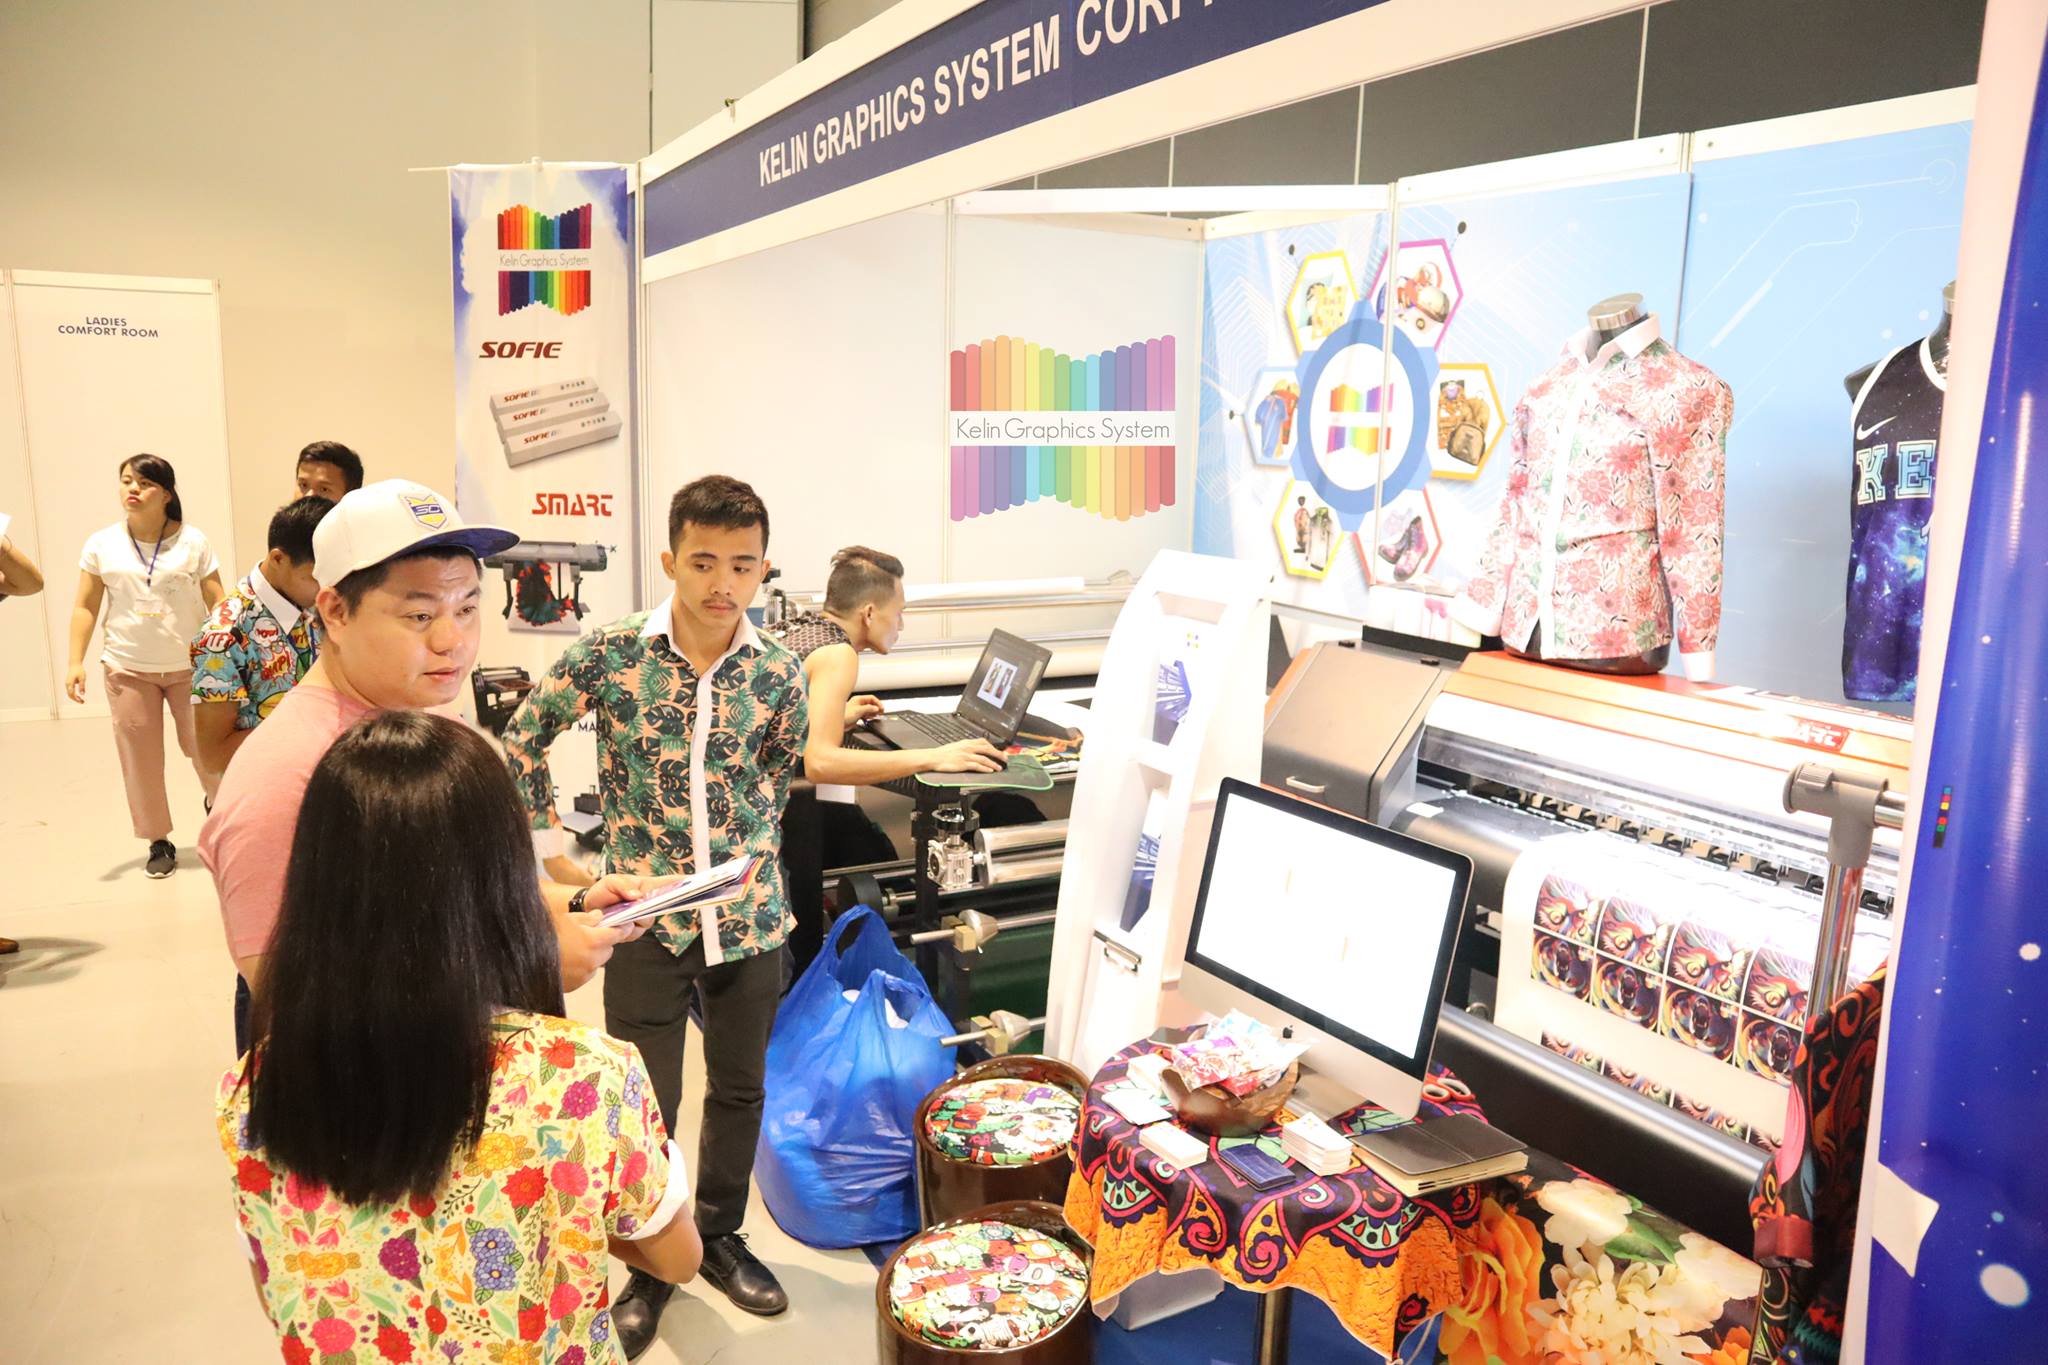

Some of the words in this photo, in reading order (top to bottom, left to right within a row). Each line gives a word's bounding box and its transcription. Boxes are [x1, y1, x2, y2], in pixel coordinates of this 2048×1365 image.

[759, 131, 808, 187] KELIN
[813, 76, 926, 164] GRAPHICS
[934, 14, 1060, 115] SYSTEM
[500, 254, 519, 267] Kelin
[520, 253, 557, 269] Graphics
[560, 253, 588, 269] System
[58, 324, 117, 336] COMFORT
[121, 328, 159, 338] ROOM
[86, 316, 127, 327] LADIES
[479, 341, 563, 359] SOFIE
[956, 417, 1001, 440] Kelin
[1004, 417, 1096, 443] Graphics
[1100, 417, 1170, 443] System
[1856, 440, 1937, 505] KE
[532, 493, 613, 517] SMART
